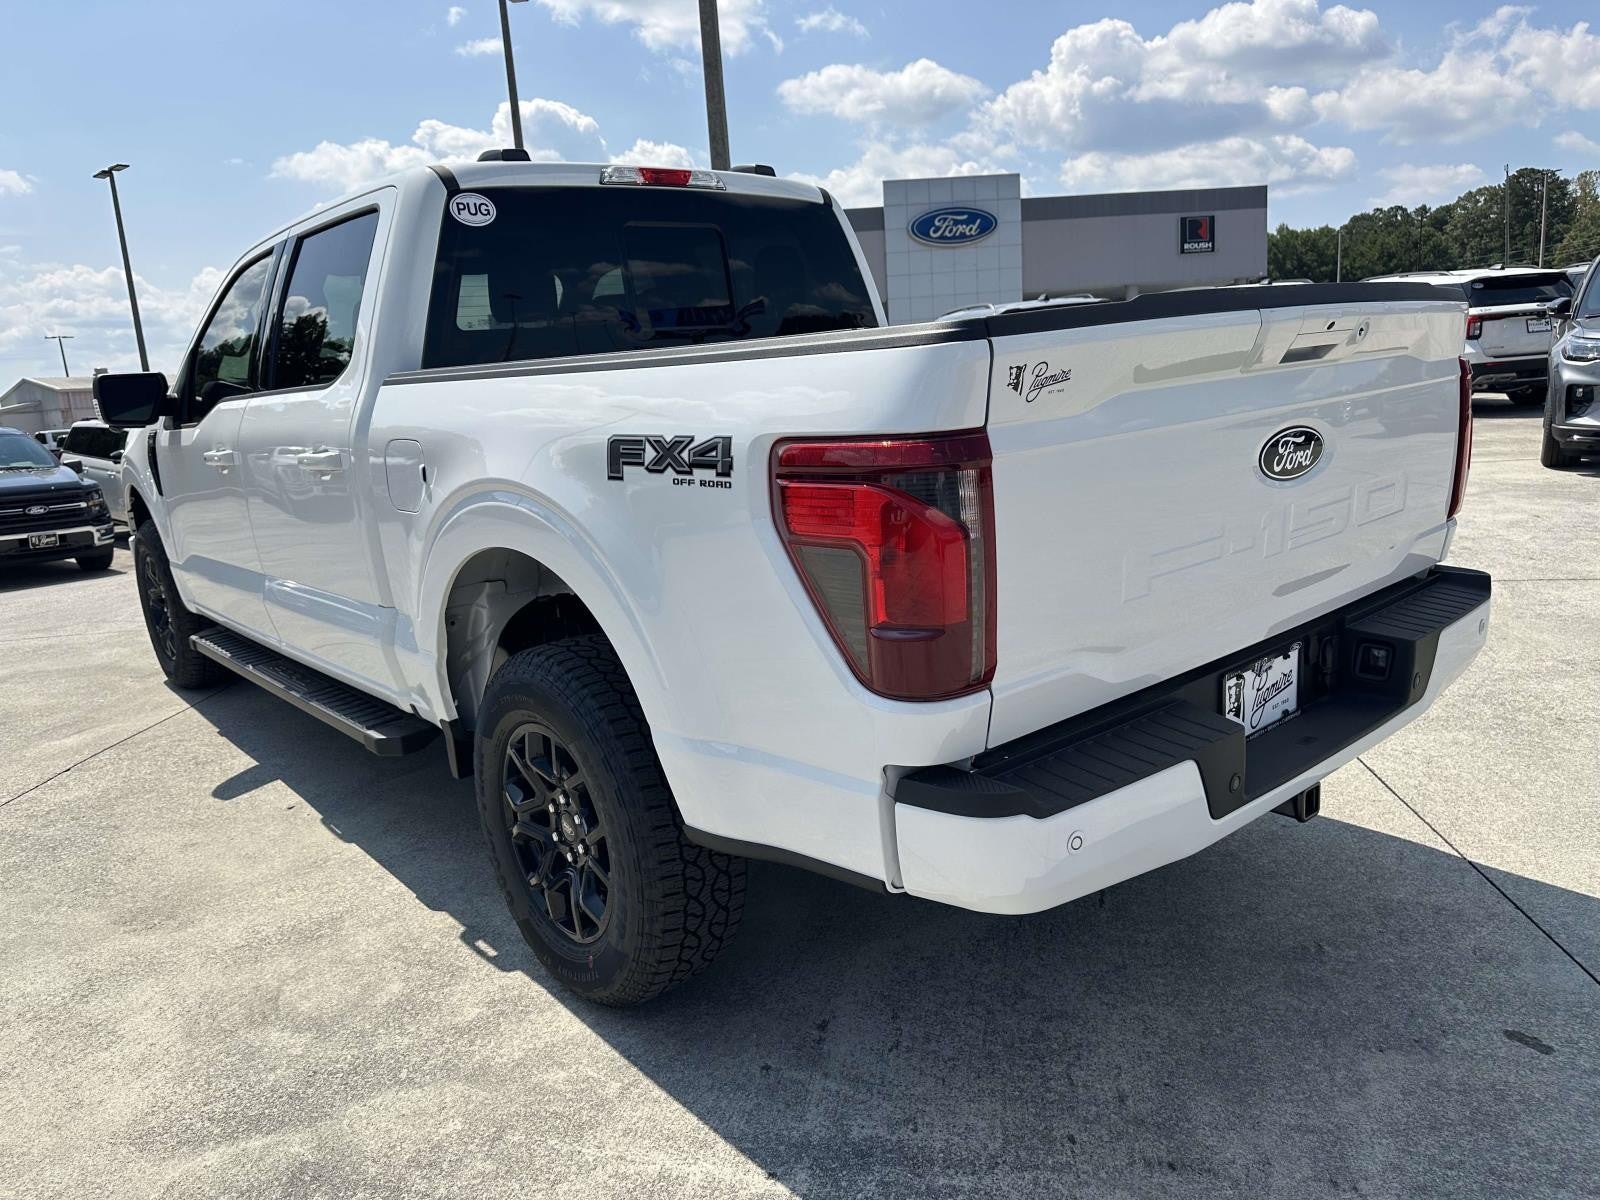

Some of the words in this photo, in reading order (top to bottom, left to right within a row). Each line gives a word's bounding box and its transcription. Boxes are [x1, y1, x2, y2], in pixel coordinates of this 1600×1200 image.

[456, 202, 490, 216] PUG
[929, 215, 981, 238] Ford
[1184, 242, 1213, 250] ROUSH
[1025, 361, 1072, 403] Pugmire
[607, 434, 734, 481] FX4
[1273, 435, 1315, 472] Ford
[672, 478, 696, 486] OFF
[699, 479, 732, 489] ROAD
[1250, 669, 1294, 729] Pugmire
